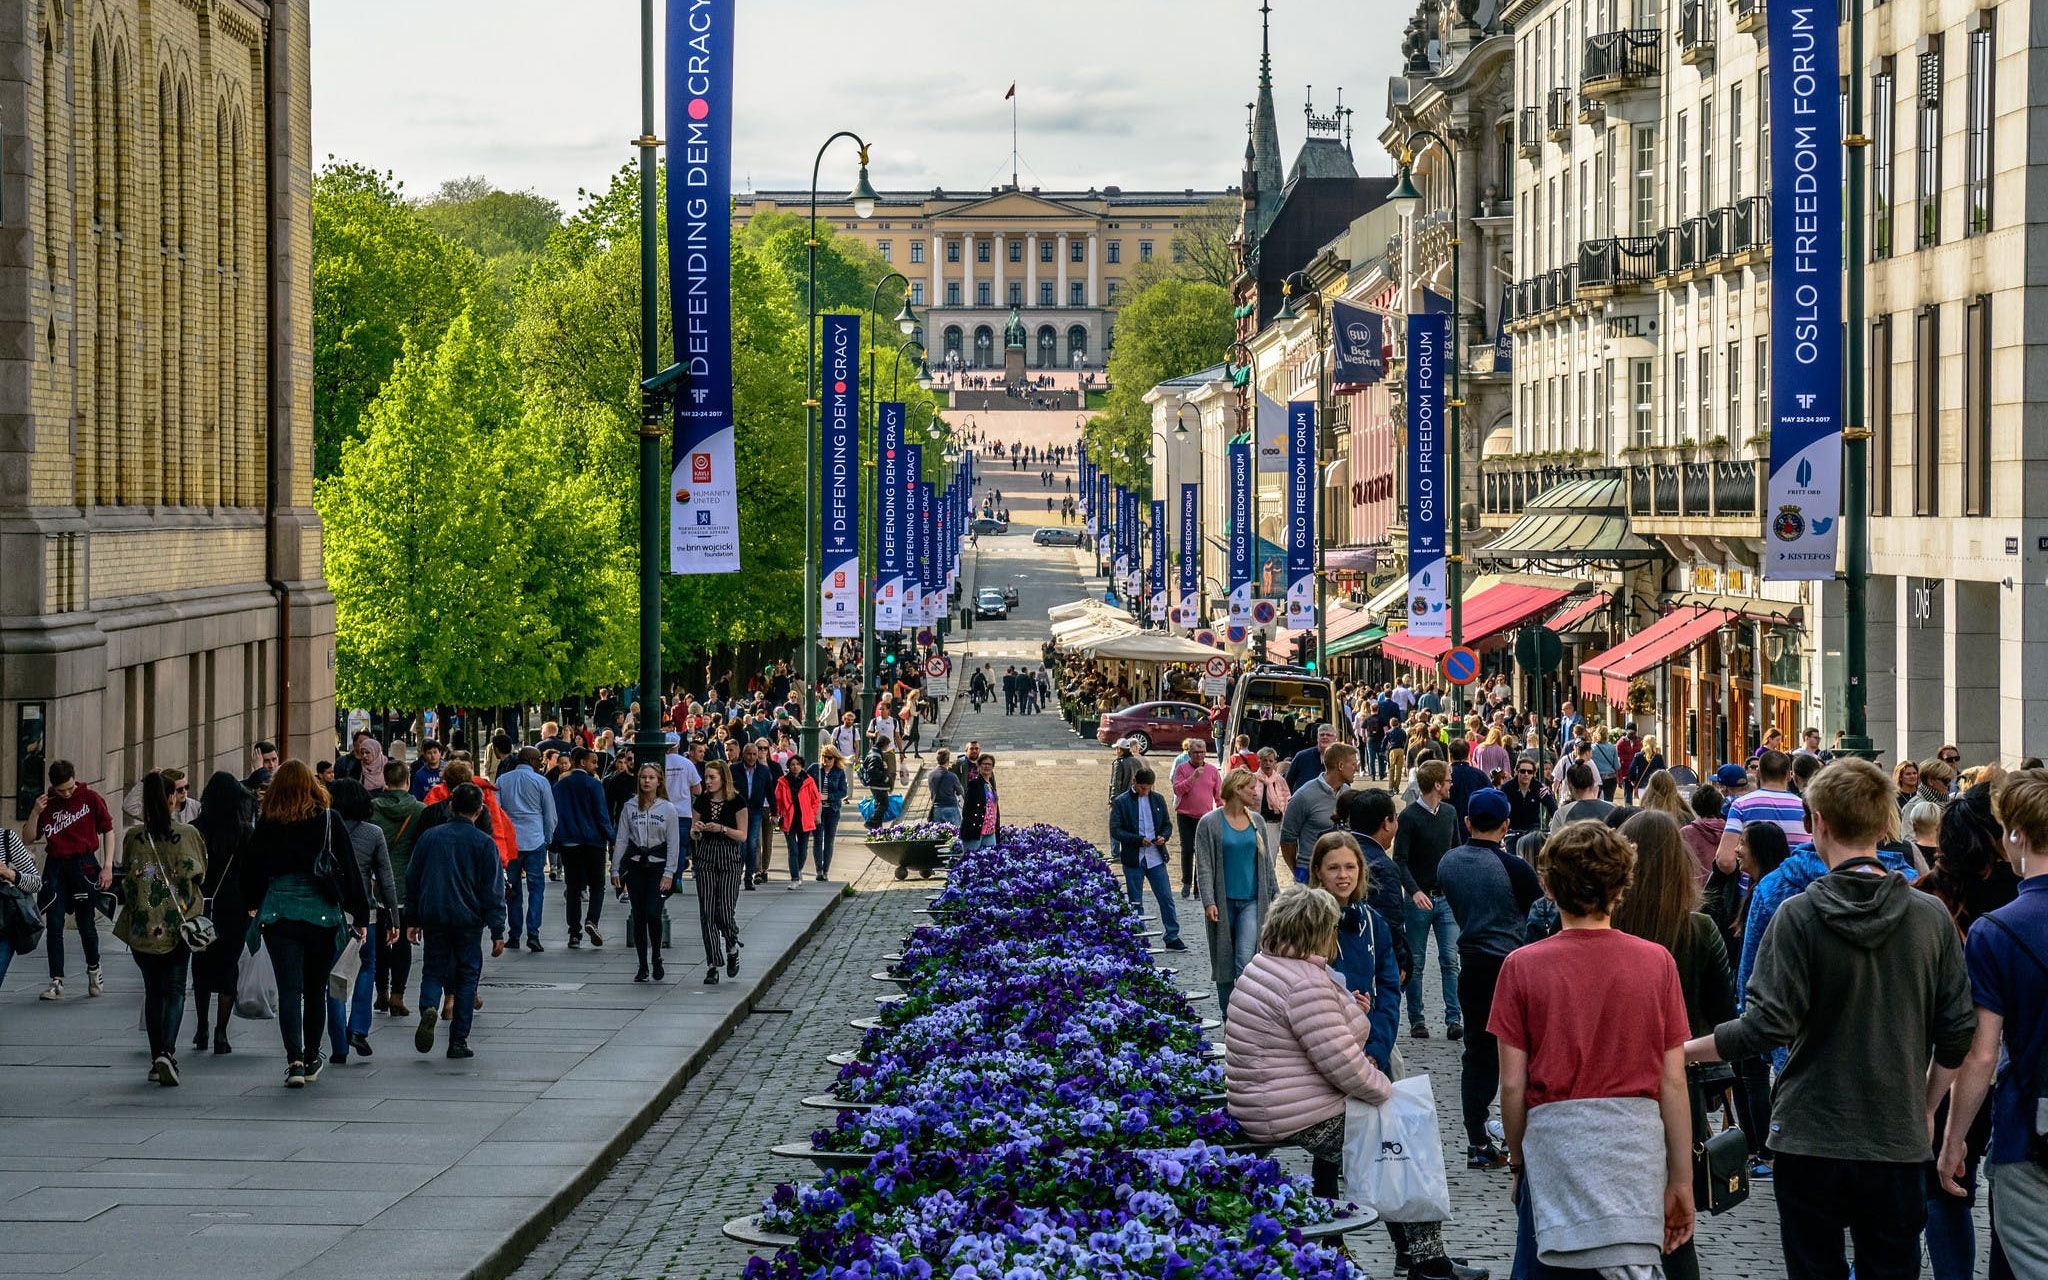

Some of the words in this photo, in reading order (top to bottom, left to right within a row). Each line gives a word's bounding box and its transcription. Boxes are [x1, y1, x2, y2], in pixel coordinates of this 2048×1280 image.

[1791, 8, 1816, 115] FORUM
[1794, 126, 1818, 273] FREEDOM
[687, 198, 709, 376] DEFENDING
[1349, 330, 1368, 340] BW
[1603, 315, 1647, 339] HOTEL
[1795, 284, 1818, 365] OSLO
[1420, 331, 1433, 389] FORUM
[1296, 413, 1307, 454] FORUM
[1420, 395, 1433, 473] FREEDOM
[834, 435, 847, 531] DEFENDING
[1236, 453, 1246, 486] FORUM
[1296, 458, 1307, 513] FREEDOM
[693, 490, 731, 498] HUMANITY
[1236, 488, 1246, 534] FREEDOM
[1420, 478, 1433, 522] OSLO
[886, 488, 897, 557] DEFENDING
[906, 513, 915, 569] DEFENDING
[1296, 516, 1307, 549] OSLO
[686, 543, 701, 552] brin
[702, 542, 733, 552] wojcicki
[1236, 536, 1246, 562] OSLO
[1787, 552, 1831, 560] KISTEFOS
[1915, 588, 1930, 619] DNB
[43, 803, 90, 838] Hundreds
